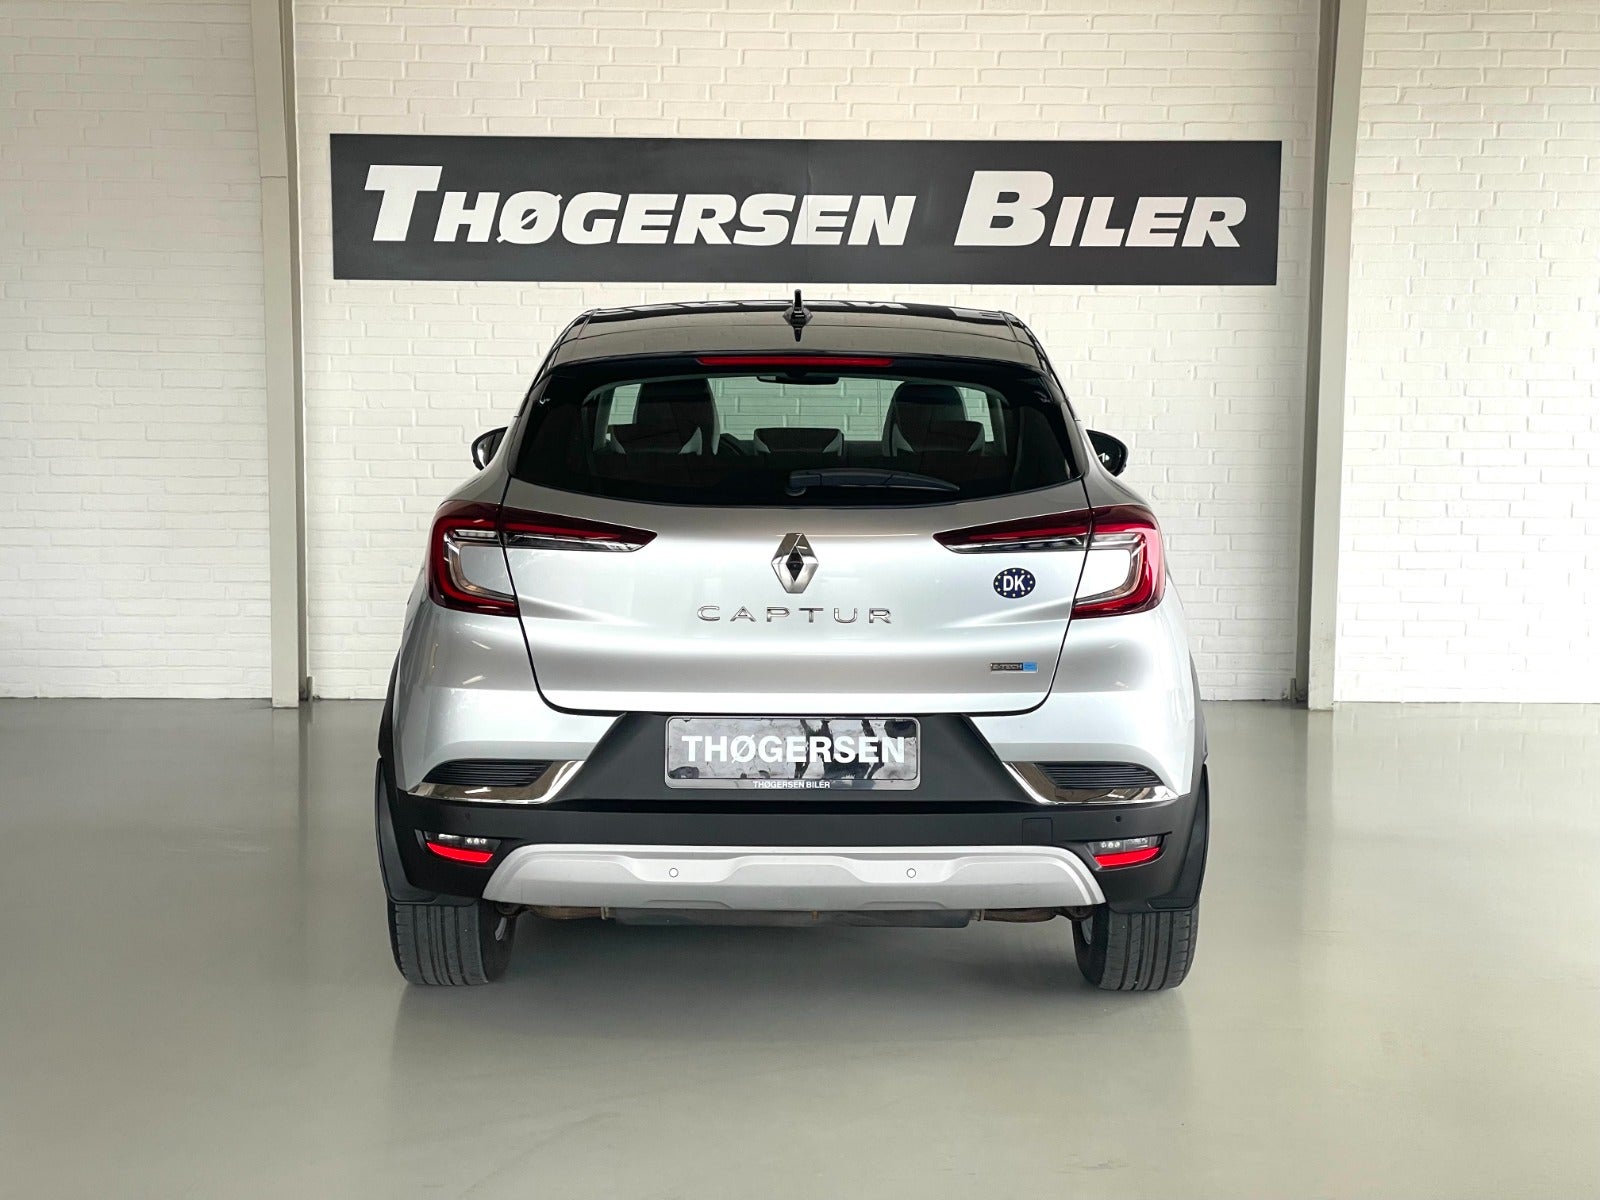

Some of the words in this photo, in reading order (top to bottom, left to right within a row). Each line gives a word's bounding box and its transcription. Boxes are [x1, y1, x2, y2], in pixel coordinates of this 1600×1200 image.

[954, 170, 1247, 248] BILER
[1002, 575, 1025, 591] DK
[697, 605, 892, 624] CAPTUR
[682, 735, 904, 764] THØGERSEN
[753, 780, 804, 789] THØGERSEN
[806, 780, 830, 789] BILER
